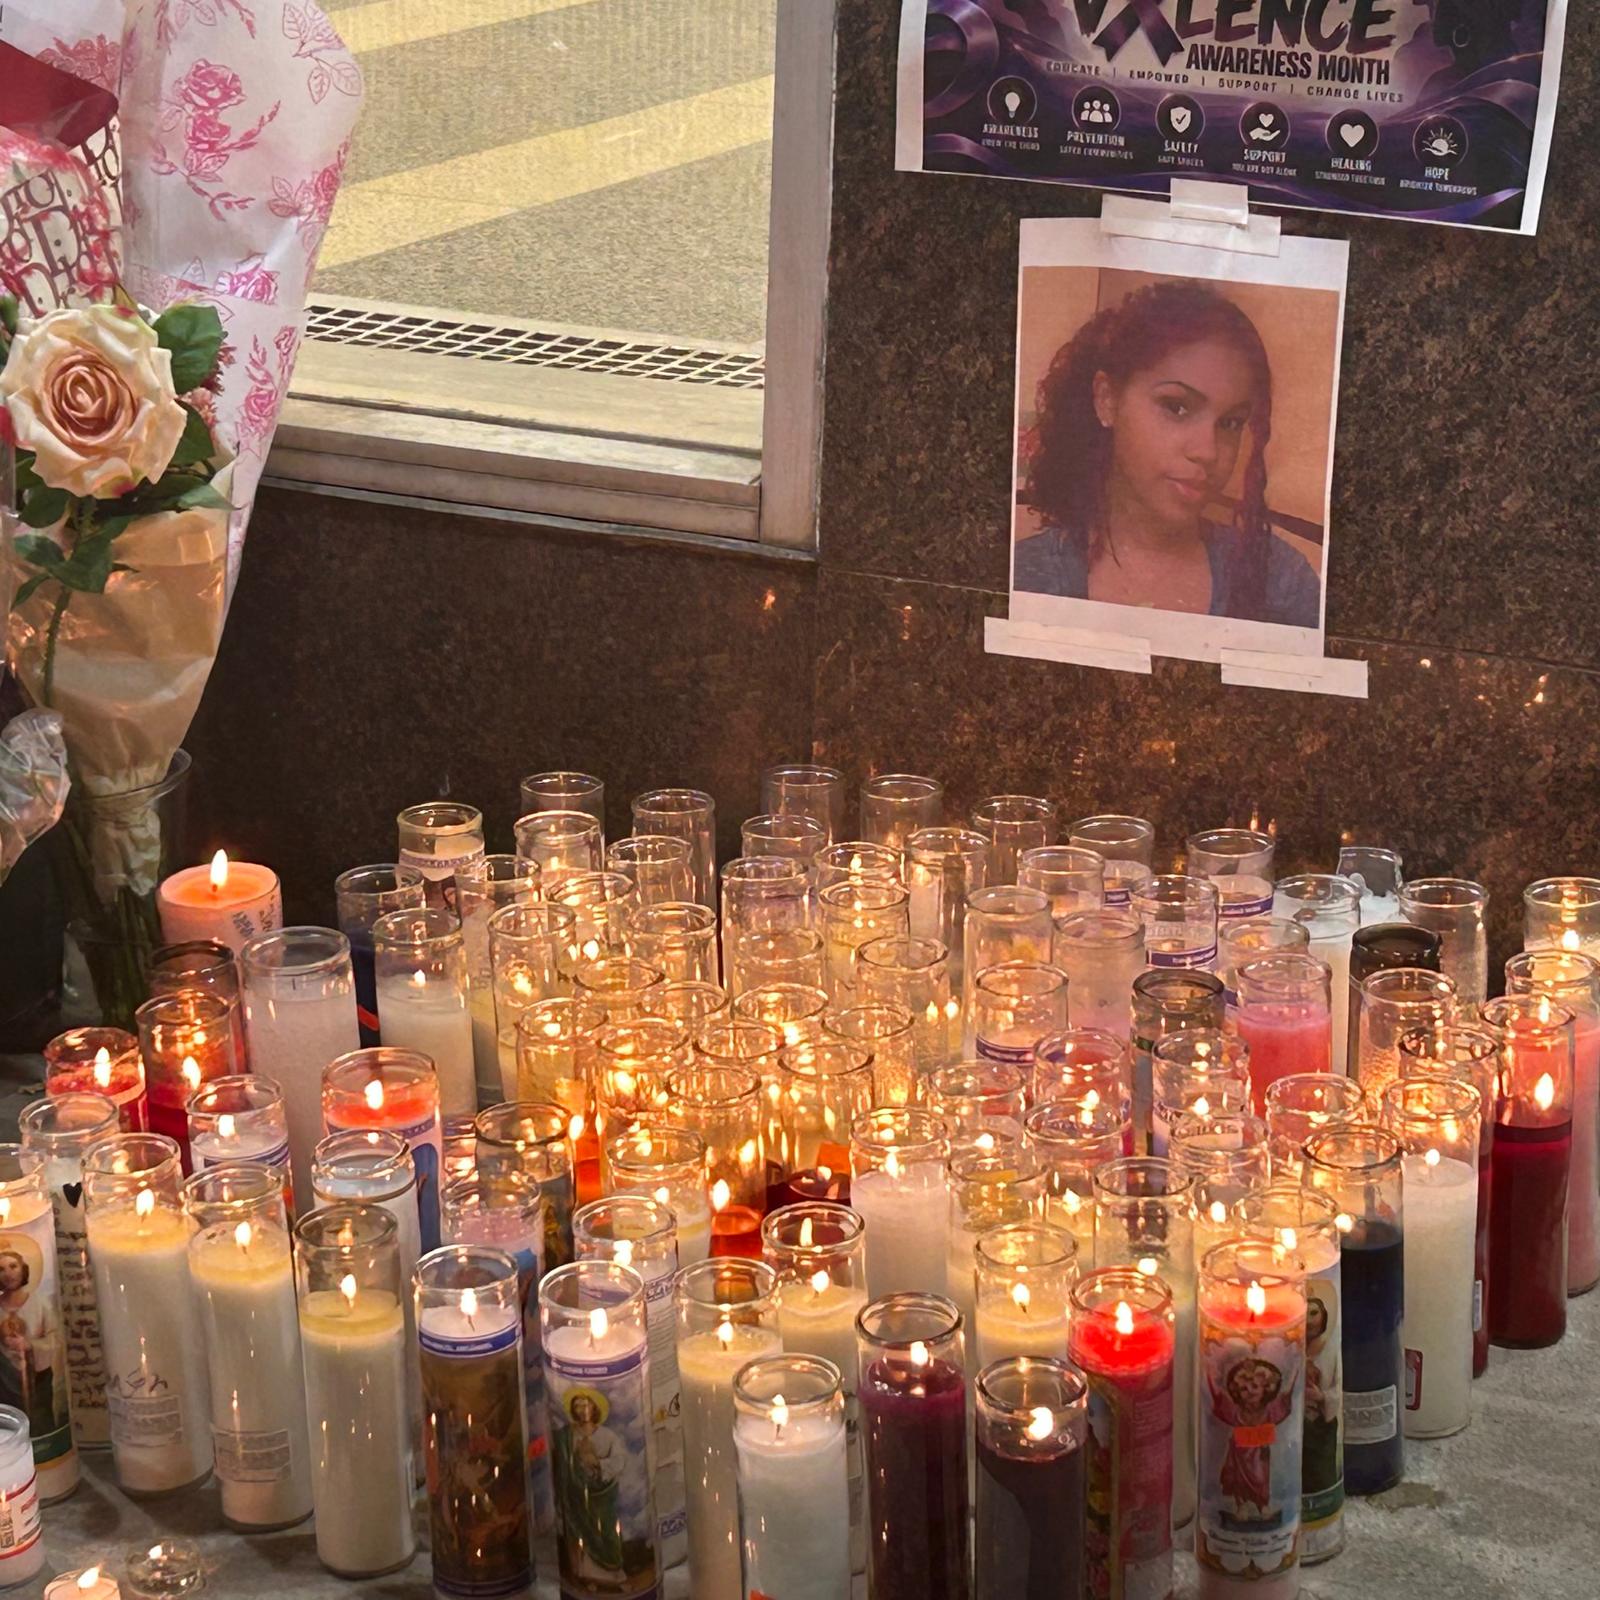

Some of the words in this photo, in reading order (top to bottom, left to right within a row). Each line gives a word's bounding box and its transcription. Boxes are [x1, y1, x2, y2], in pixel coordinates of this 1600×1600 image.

[1186, 43, 1312, 79] AWARENESS
[1317, 54, 1390, 85] MONTH
[1218, 78, 1278, 92] SUPPORT
[1307, 86, 1360, 100] CHANGE
[1367, 91, 1403, 103] LIVES
[1424, 167, 1450, 181] HOPE
